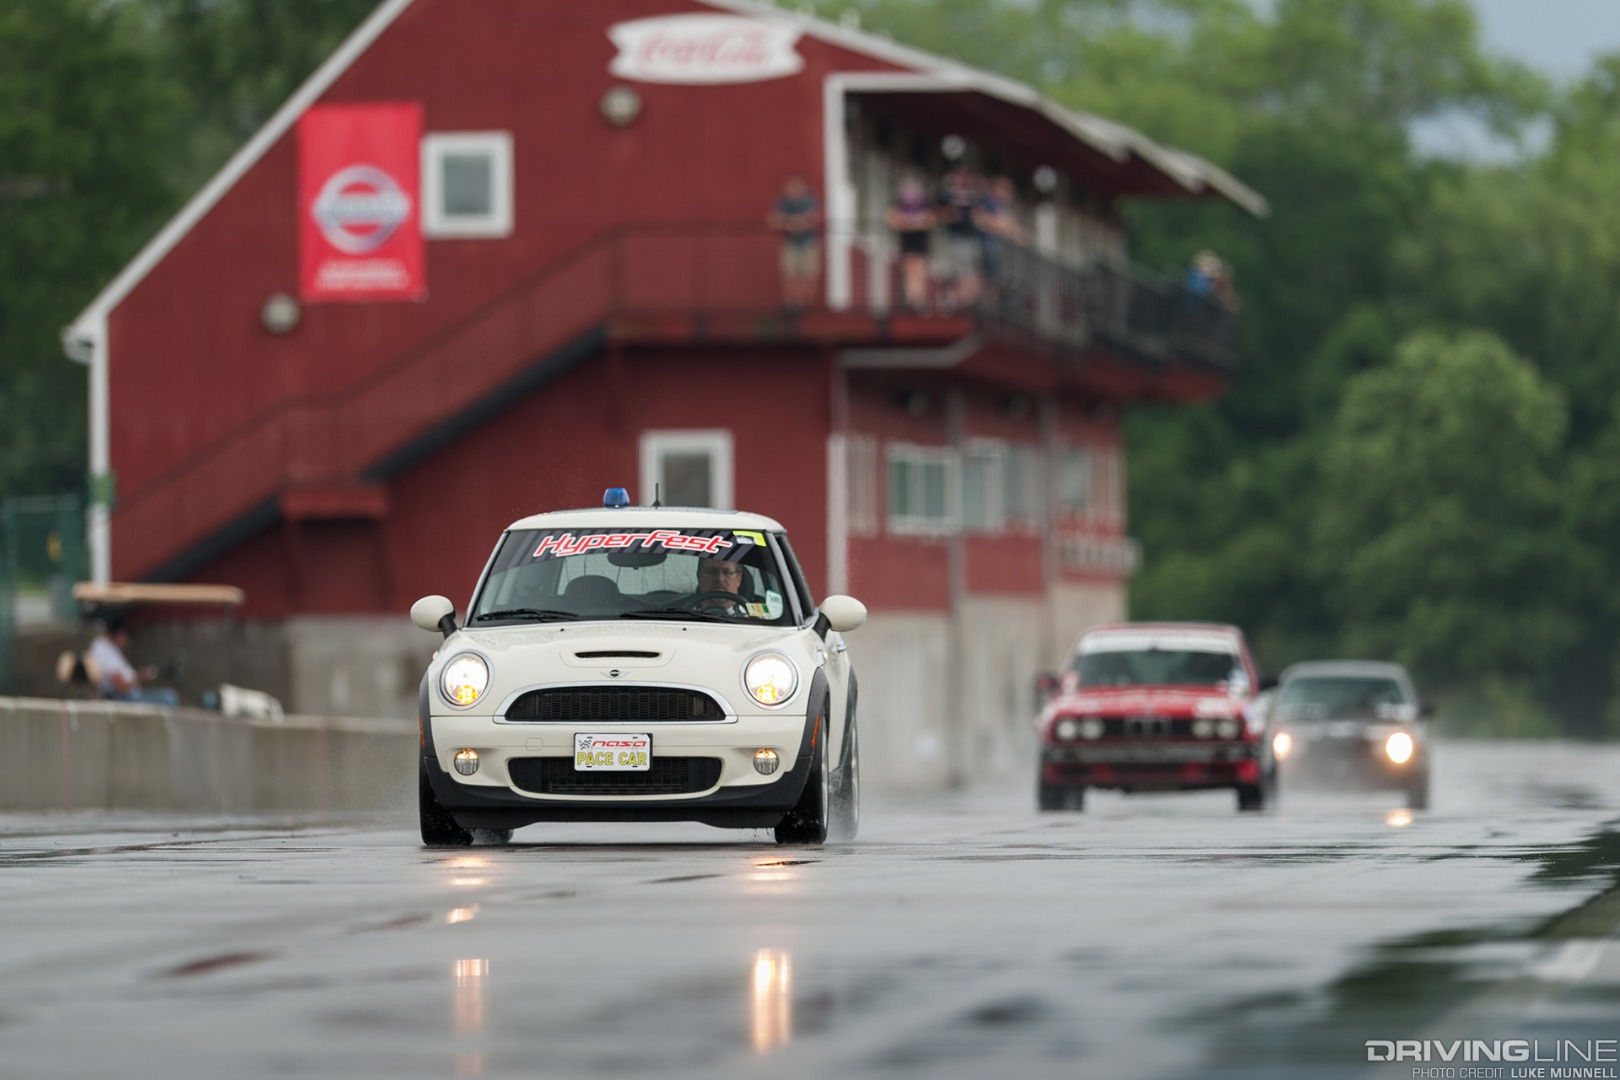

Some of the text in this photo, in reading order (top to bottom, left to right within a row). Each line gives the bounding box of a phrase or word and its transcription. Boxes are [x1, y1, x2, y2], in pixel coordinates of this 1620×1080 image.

[533, 530, 732, 557] HyperFest
[577, 751, 647, 766] PACE CAR
